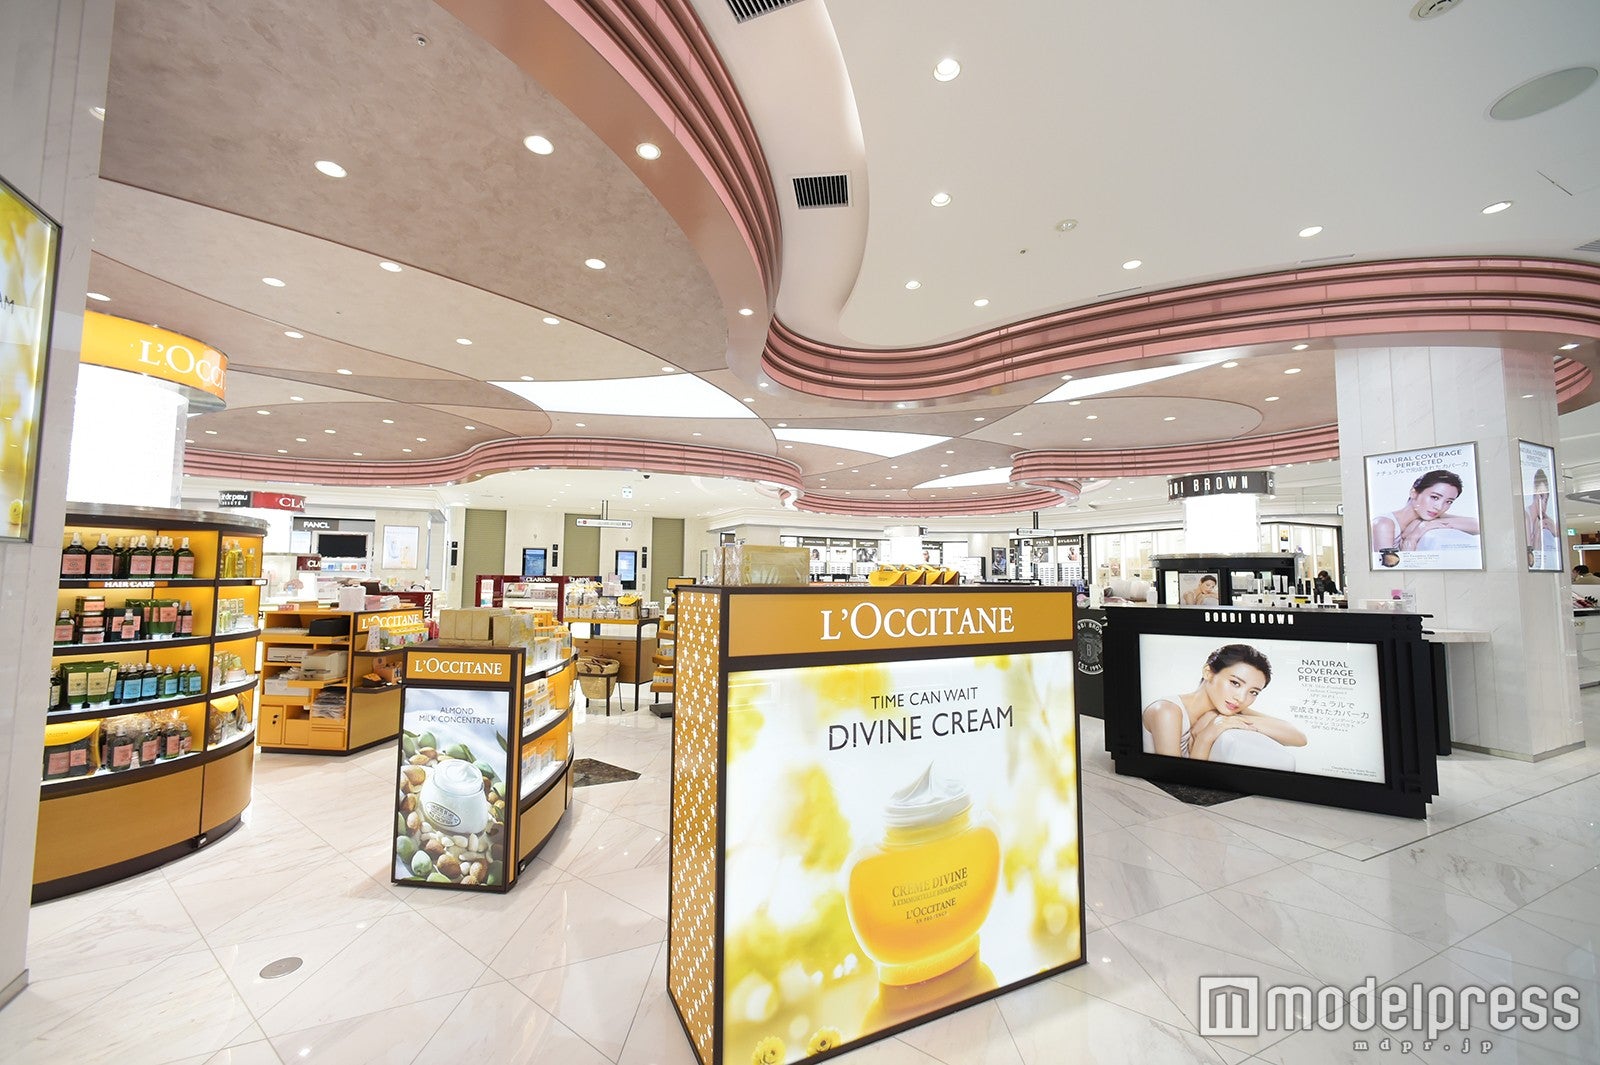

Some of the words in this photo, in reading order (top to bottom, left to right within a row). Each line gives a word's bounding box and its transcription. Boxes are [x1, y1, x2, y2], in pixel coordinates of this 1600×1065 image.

[1376, 456, 1413, 465] NATURAL
[1414, 449, 1462, 461] COVERAGE
[1396, 458, 1443, 468] PERFECTED
[1193, 475, 1249, 492] BROWN
[303, 521, 330, 529] FANCL
[104, 580, 130, 588] HAIR
[129, 580, 156, 588] CARE
[820, 602, 1015, 641] L'OCCITANE
[1204, 611, 1242, 623] BOBBI
[1250, 612, 1294, 625] BROWN
[414, 657, 503, 675] L'OCCITANE
[1301, 659, 1349, 669] NATURAL
[1297, 666, 1354, 677] COVERAGE
[1298, 675, 1357, 685] PERFECTED
[871, 693, 905, 709] TIME
[909, 690, 941, 706] CAN
[943, 686, 978, 702] WAIT
[440, 706, 474, 715] ALMOND
[438, 716, 496, 726] CONCENTRATE
[829, 715, 922, 751] DIVINE
[932, 705, 1014, 737] CREAM
[932, 866, 969, 890] DIVINE
[905, 897, 958, 920] L'OCCITANE
